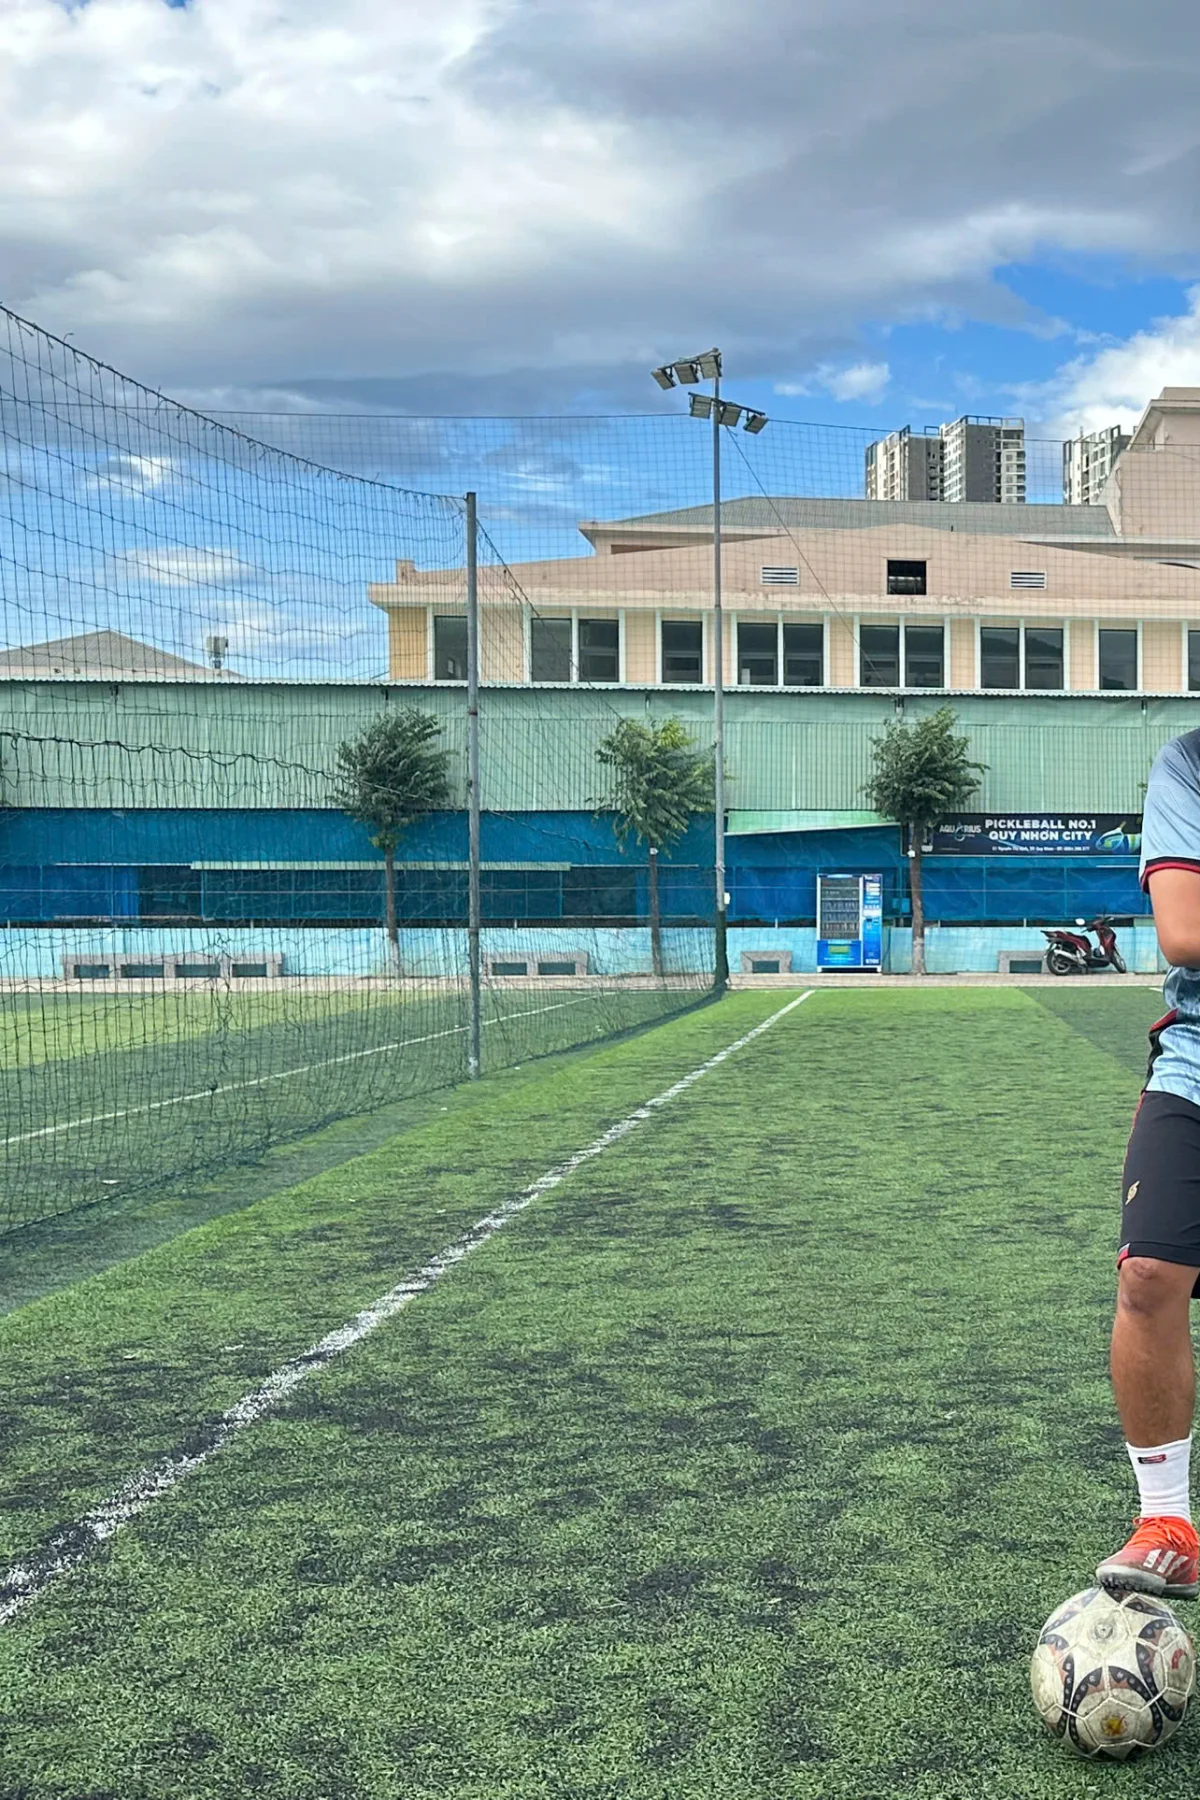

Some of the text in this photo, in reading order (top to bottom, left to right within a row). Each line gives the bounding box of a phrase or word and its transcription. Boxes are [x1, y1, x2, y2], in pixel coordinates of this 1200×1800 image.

[985, 819, 1096, 829] PICKLEBALL NO.1
[989, 830, 1017, 841] QUY
[1062, 830, 1093, 841] CITY
